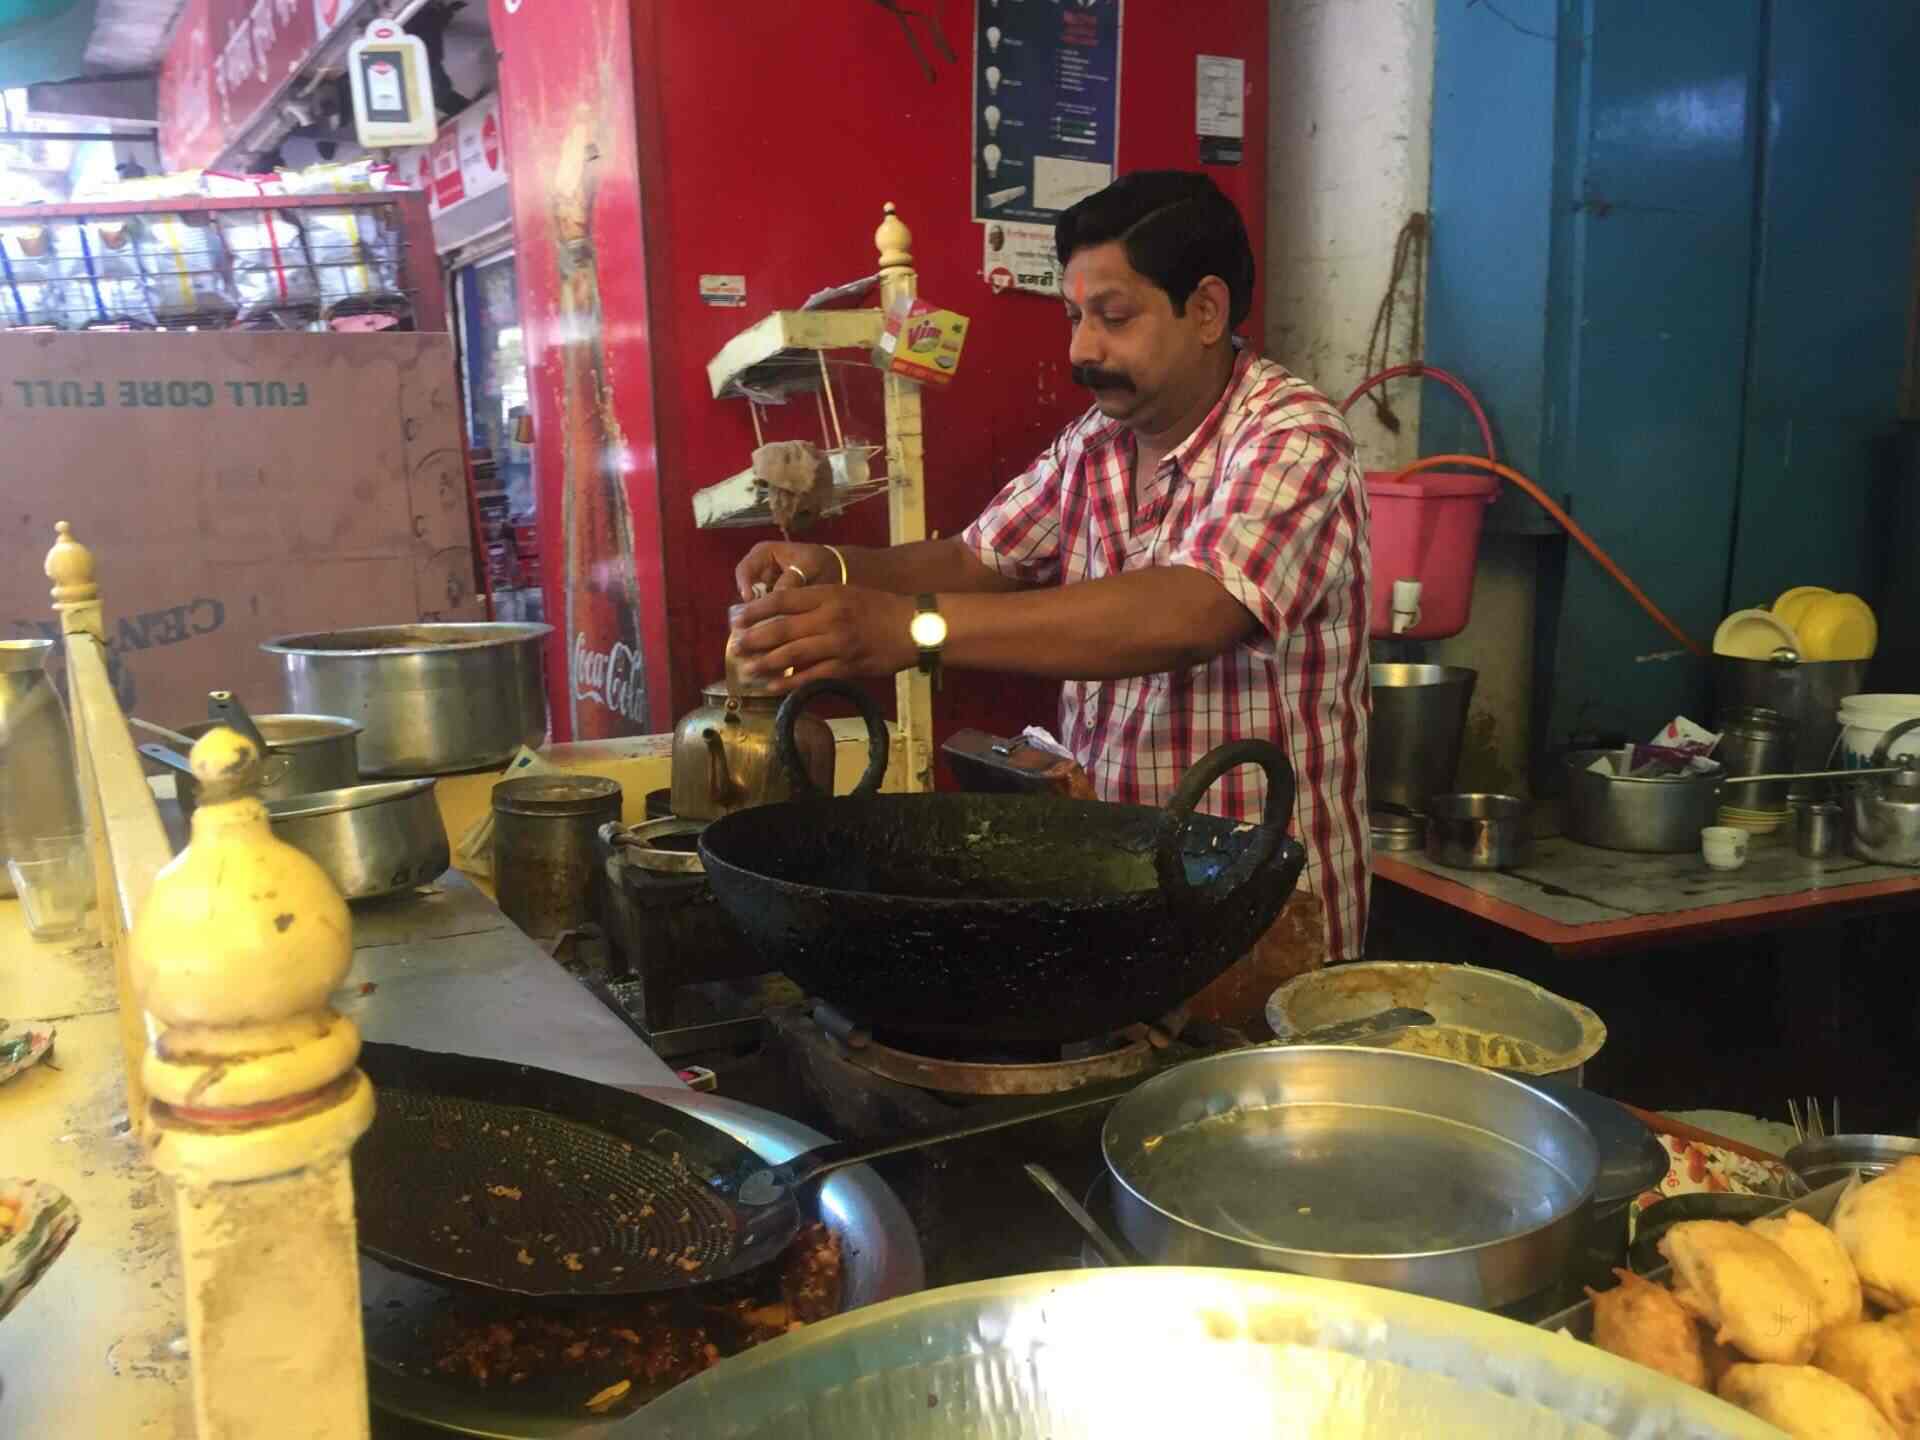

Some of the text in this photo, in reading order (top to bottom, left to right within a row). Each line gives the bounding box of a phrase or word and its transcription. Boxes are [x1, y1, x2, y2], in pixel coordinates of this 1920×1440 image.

[13, 379, 309, 407] FULL CORE FULL
